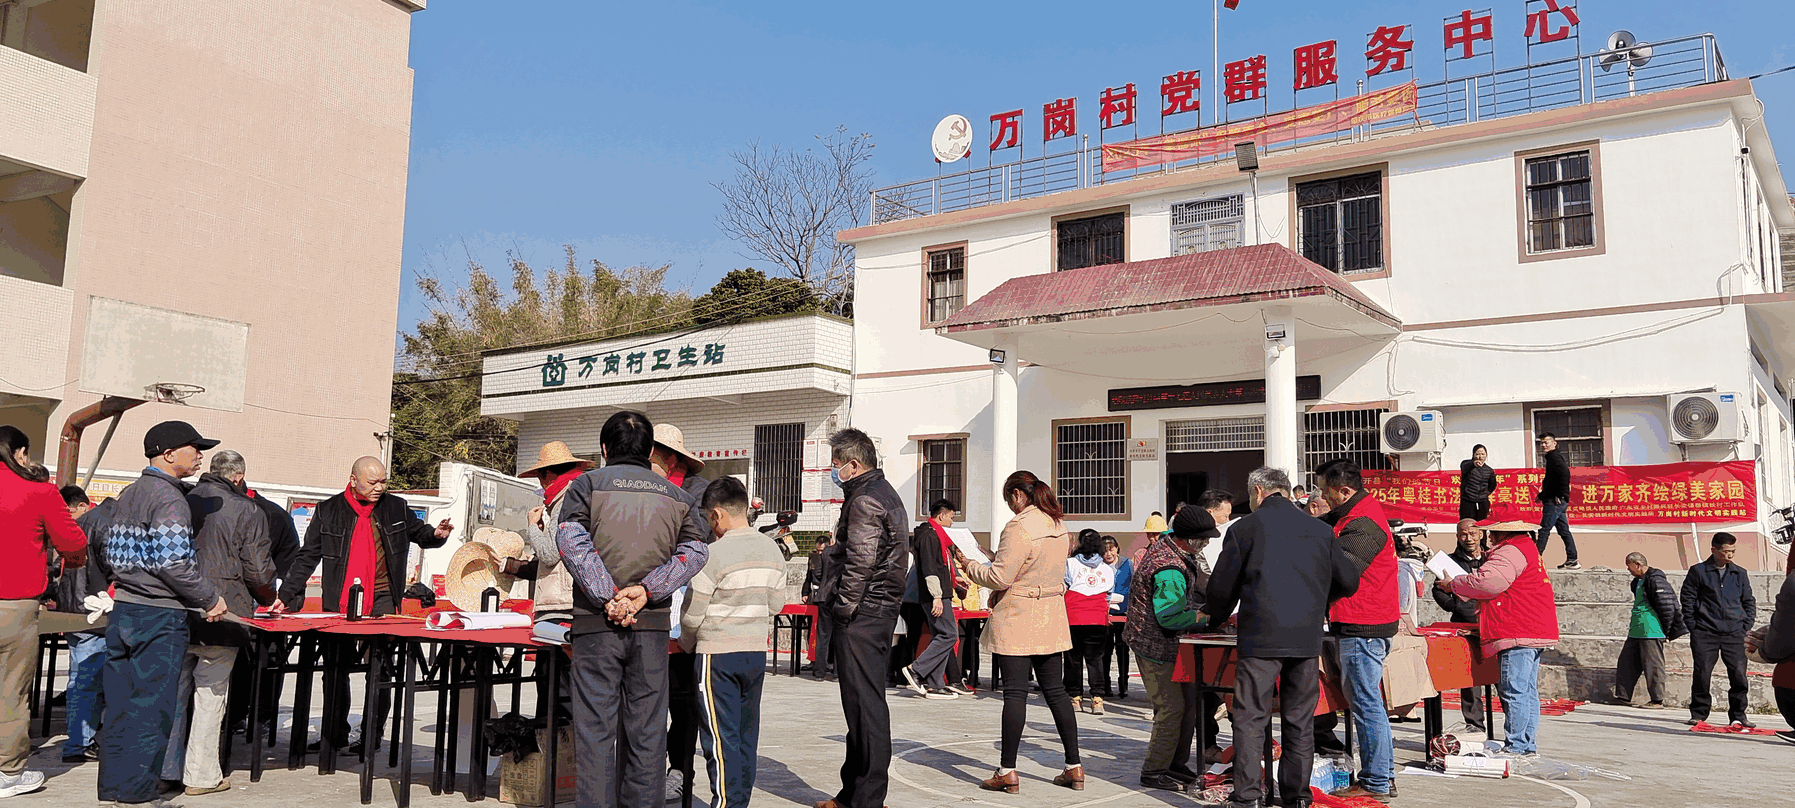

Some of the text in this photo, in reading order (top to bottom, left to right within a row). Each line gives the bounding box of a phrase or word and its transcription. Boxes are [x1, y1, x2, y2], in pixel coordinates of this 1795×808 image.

[990, 0, 1579, 150] 万岗村党群服务中心
[578, 343, 726, 380] 万岗村卫生站
[1366, 485, 1461, 505] 25年粤桂书法
[1582, 480, 1745, 503] 进万家齐绘绿美家园
